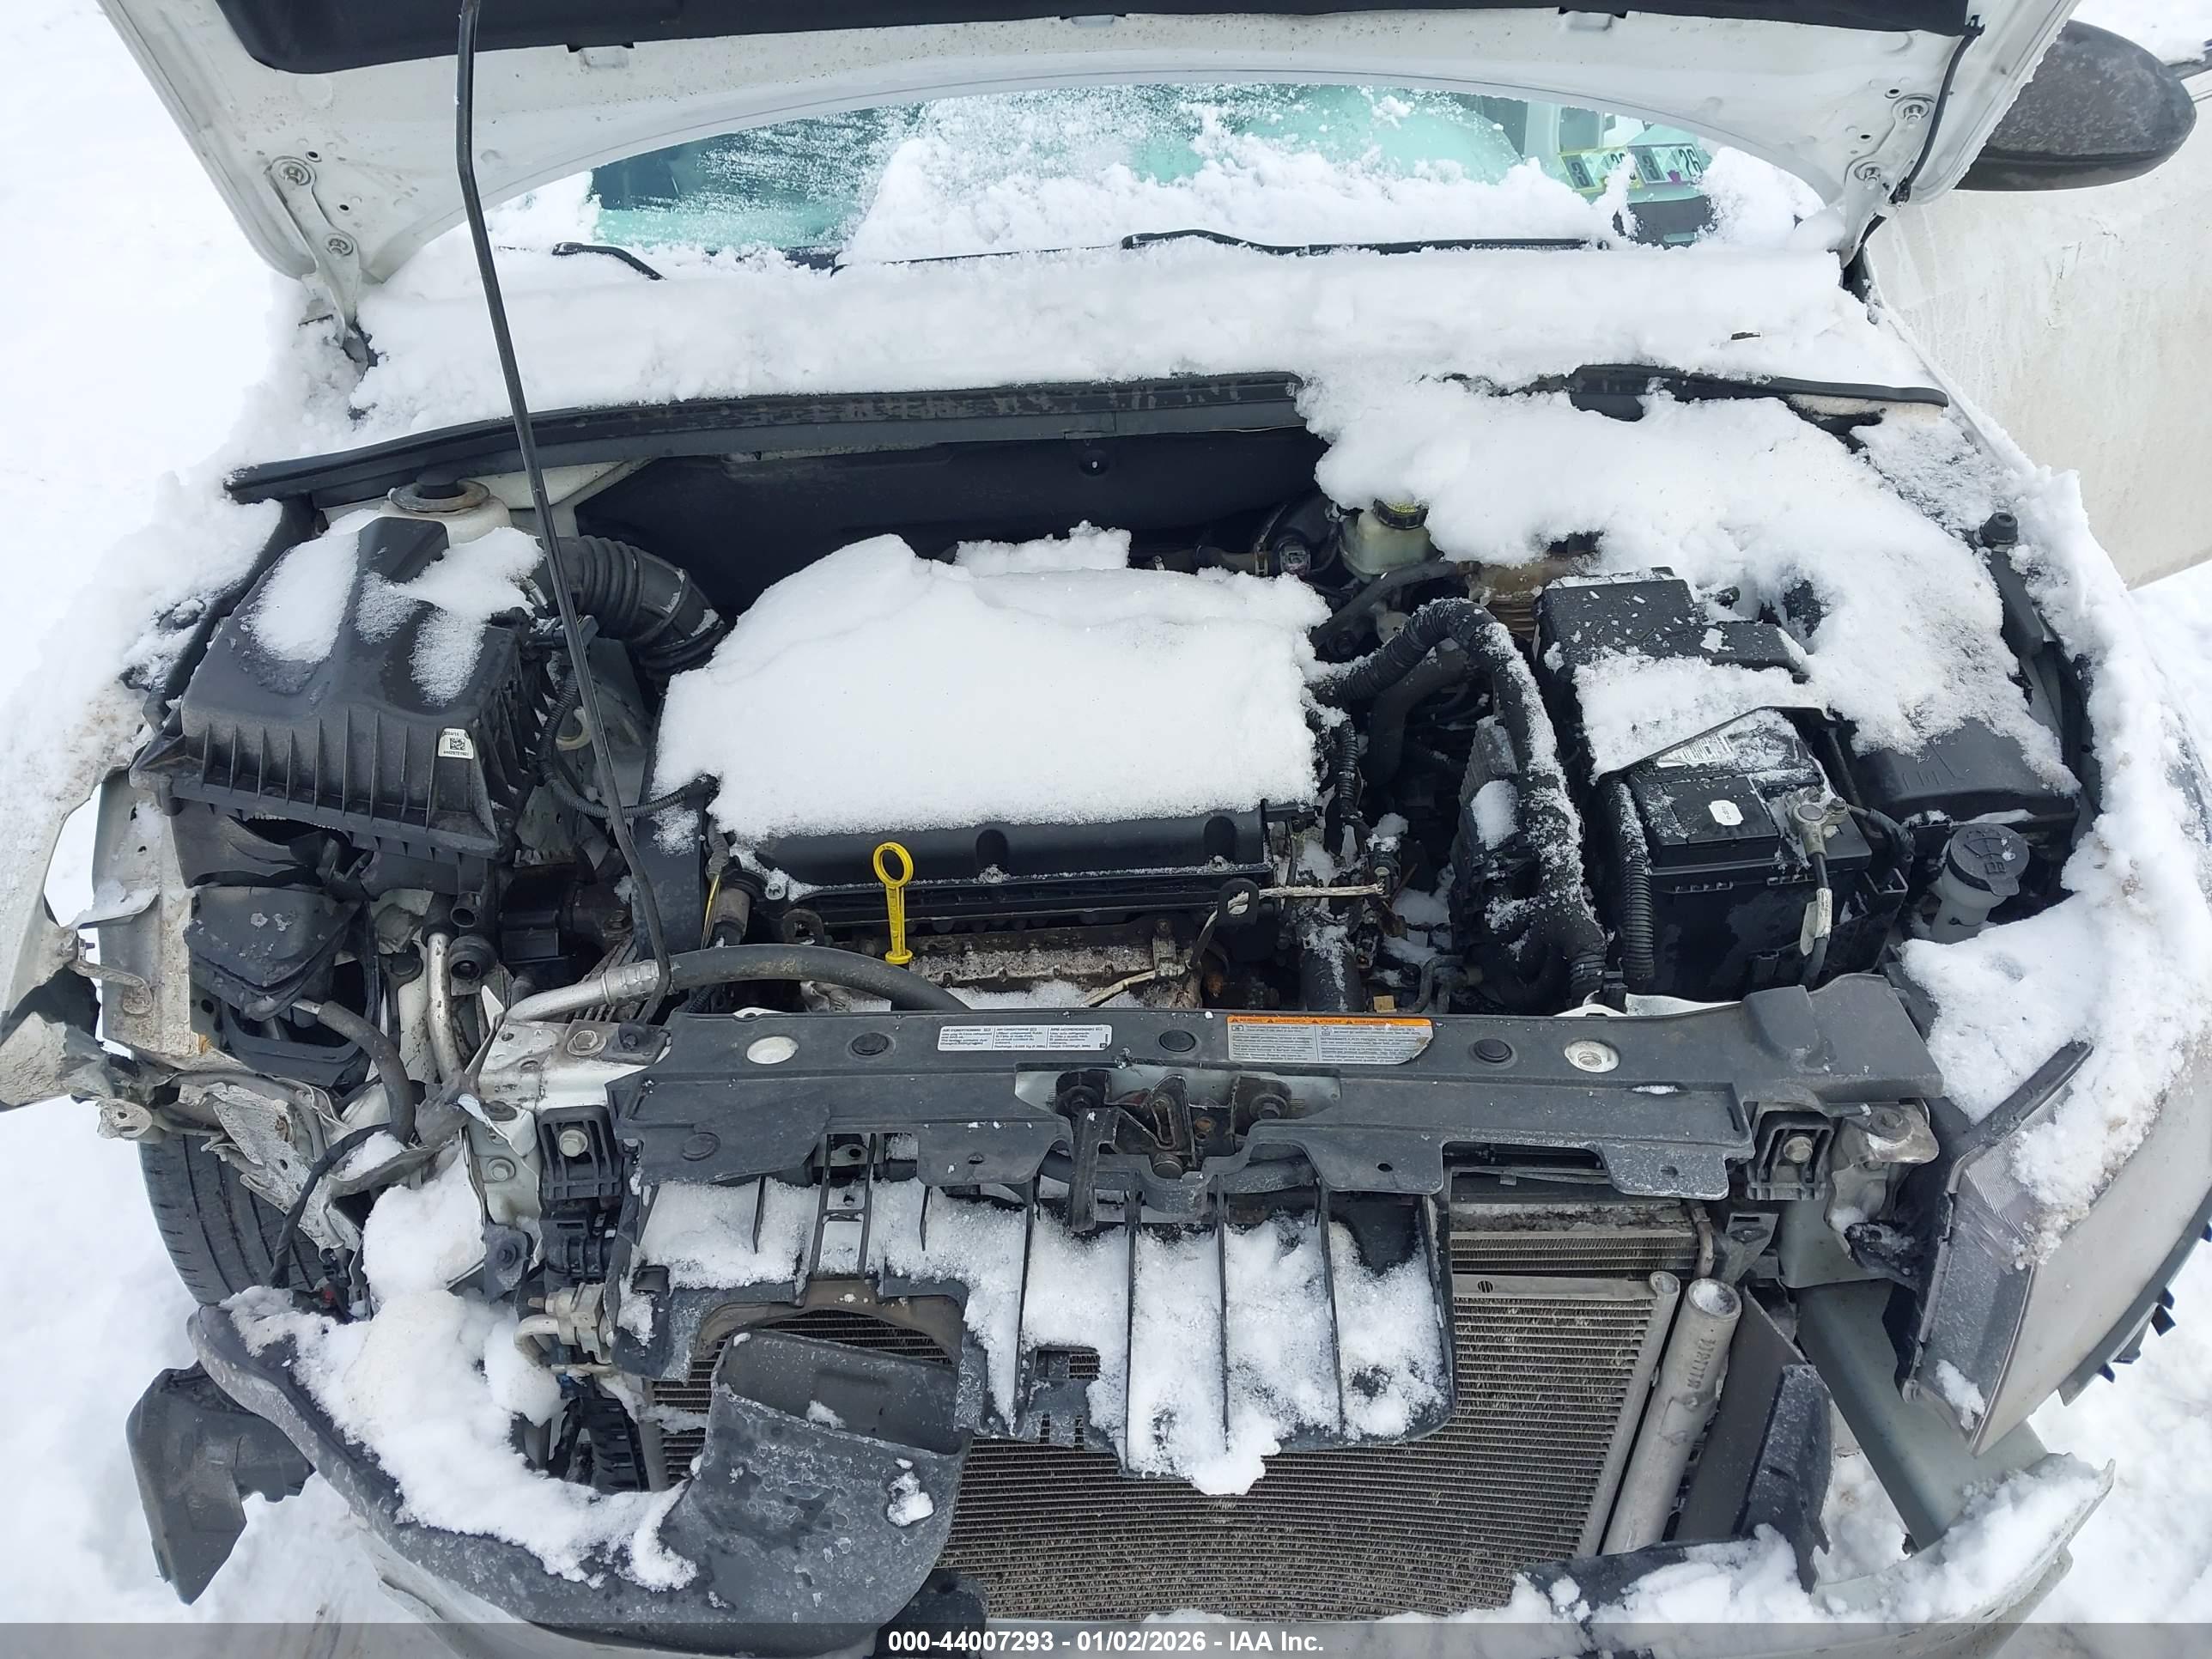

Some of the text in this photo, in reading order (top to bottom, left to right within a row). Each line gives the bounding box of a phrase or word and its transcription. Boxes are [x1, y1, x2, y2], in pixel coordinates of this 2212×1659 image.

[1571, 161, 1590, 187] 3
[1642, 155, 1661, 180] 3
[1678, 149, 1704, 177] 26
